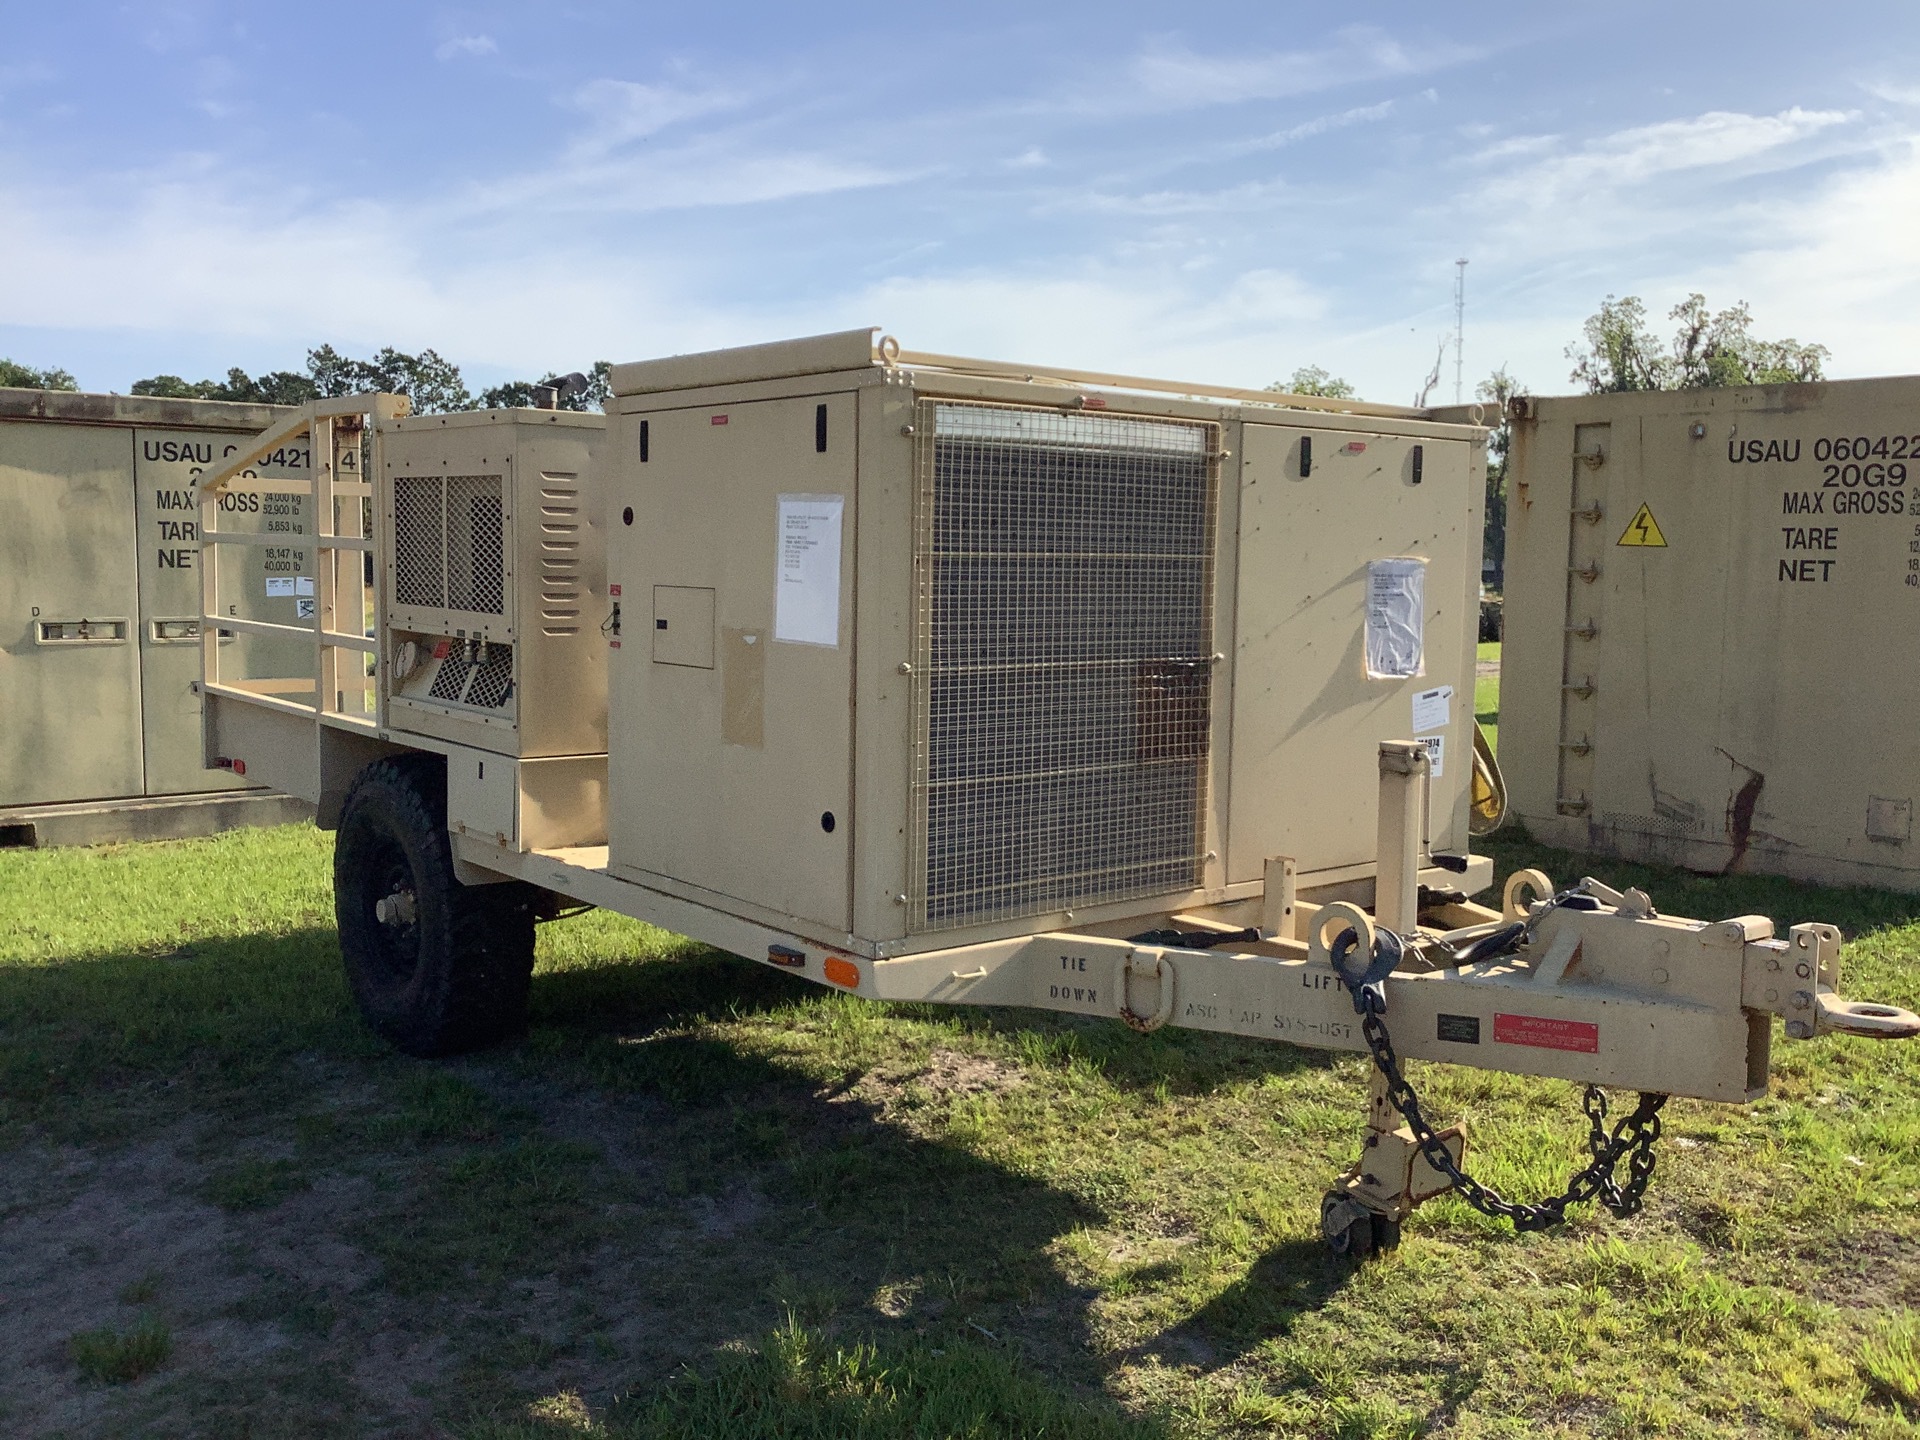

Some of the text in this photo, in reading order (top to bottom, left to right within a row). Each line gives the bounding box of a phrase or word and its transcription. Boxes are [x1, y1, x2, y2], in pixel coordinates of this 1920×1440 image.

[144, 441, 212, 463] USAU
[1728, 435, 1920, 464] USAU 060422
[1822, 463, 1907, 488] 20G9
[156, 490, 194, 510] MAX
[1782, 490, 1905, 514] MAX GROSS
[292, 522, 303, 535] kg
[1782, 527, 1839, 550] TARE
[292, 550, 304, 561] kg
[1778, 559, 1836, 582] NET
[31, 606, 40, 617] D
[229, 605, 237, 616] E
[1060, 955, 1087, 972] TIE
[1050, 985, 1097, 1003] DOWN
